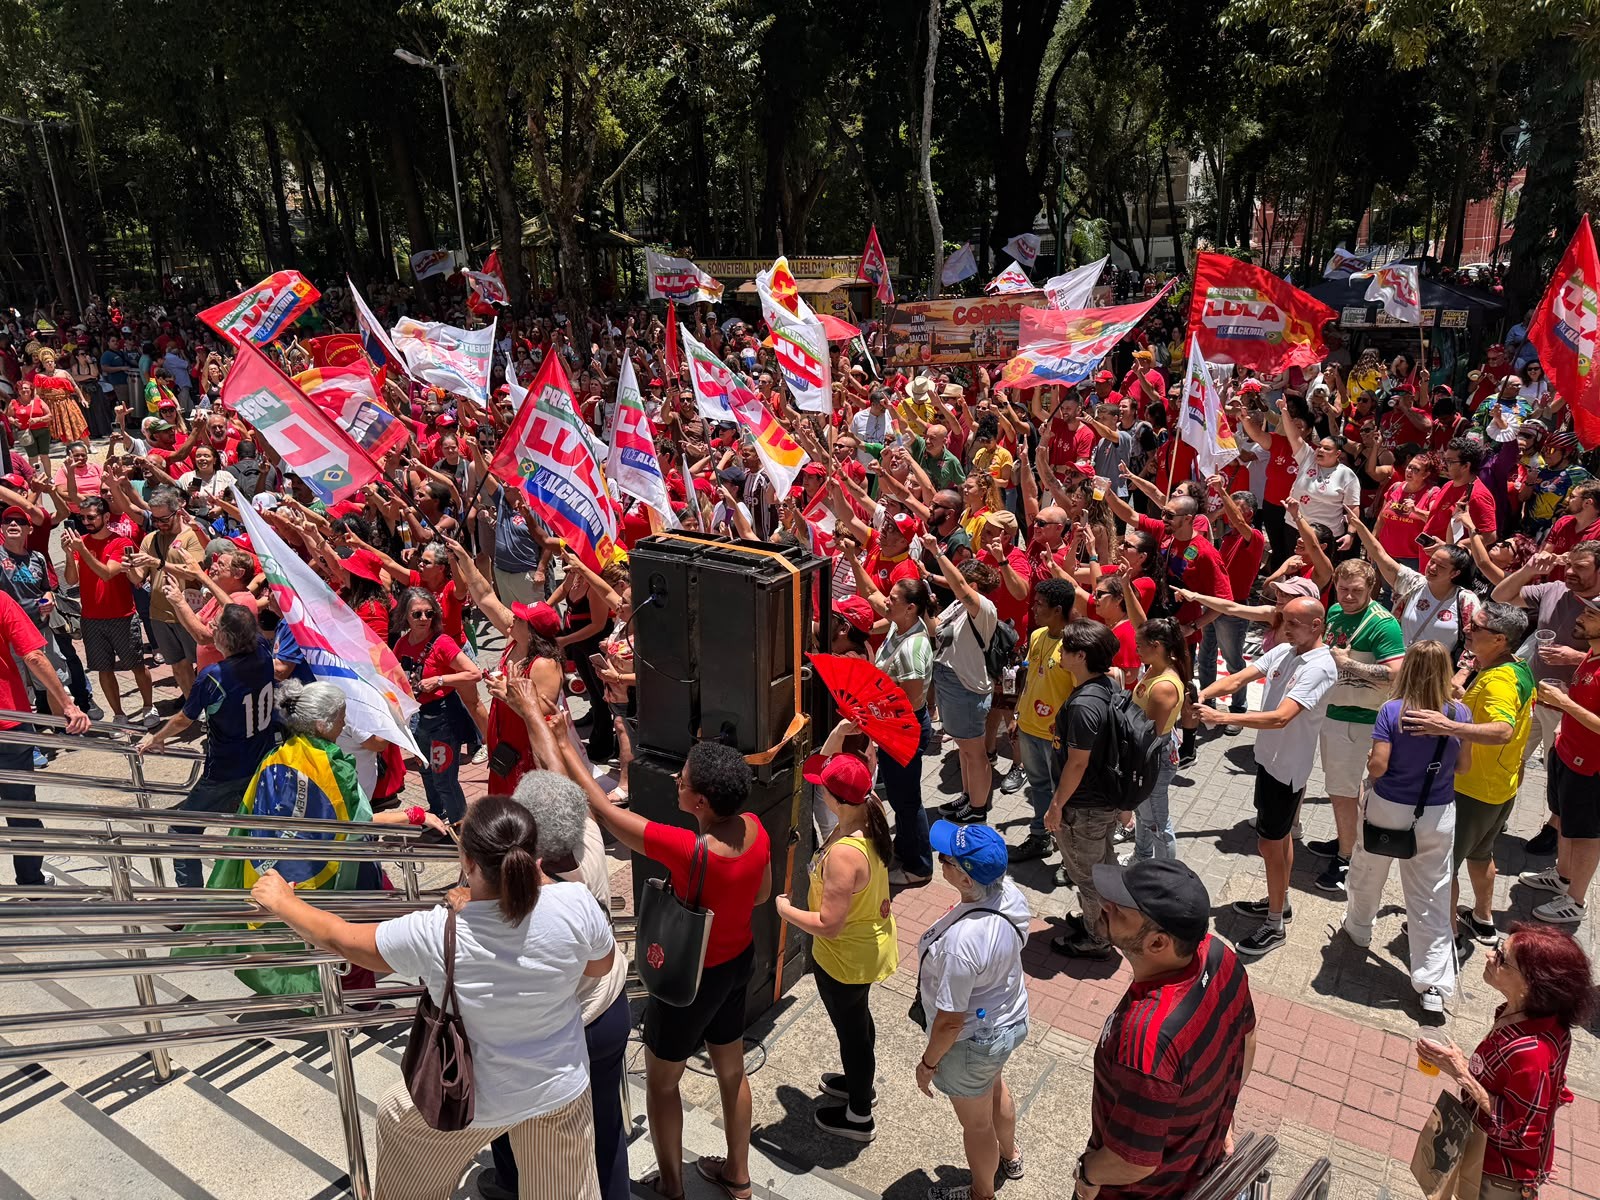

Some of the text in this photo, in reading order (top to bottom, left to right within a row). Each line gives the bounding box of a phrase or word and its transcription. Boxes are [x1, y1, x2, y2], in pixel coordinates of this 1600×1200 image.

[707, 262, 751, 274] SORVETERIA
[656, 276, 696, 287] LULA
[1207, 287, 1254, 297] PRESIDENTE
[1204, 300, 1280, 322] LULA
[911, 313, 926, 323] LIMÃO
[1227, 326, 1266, 337] ALCKMIN
[544, 473, 602, 536] ALCKMIN
[242, 682, 273, 738] 10
[297, 780, 307, 813] ORDEM
